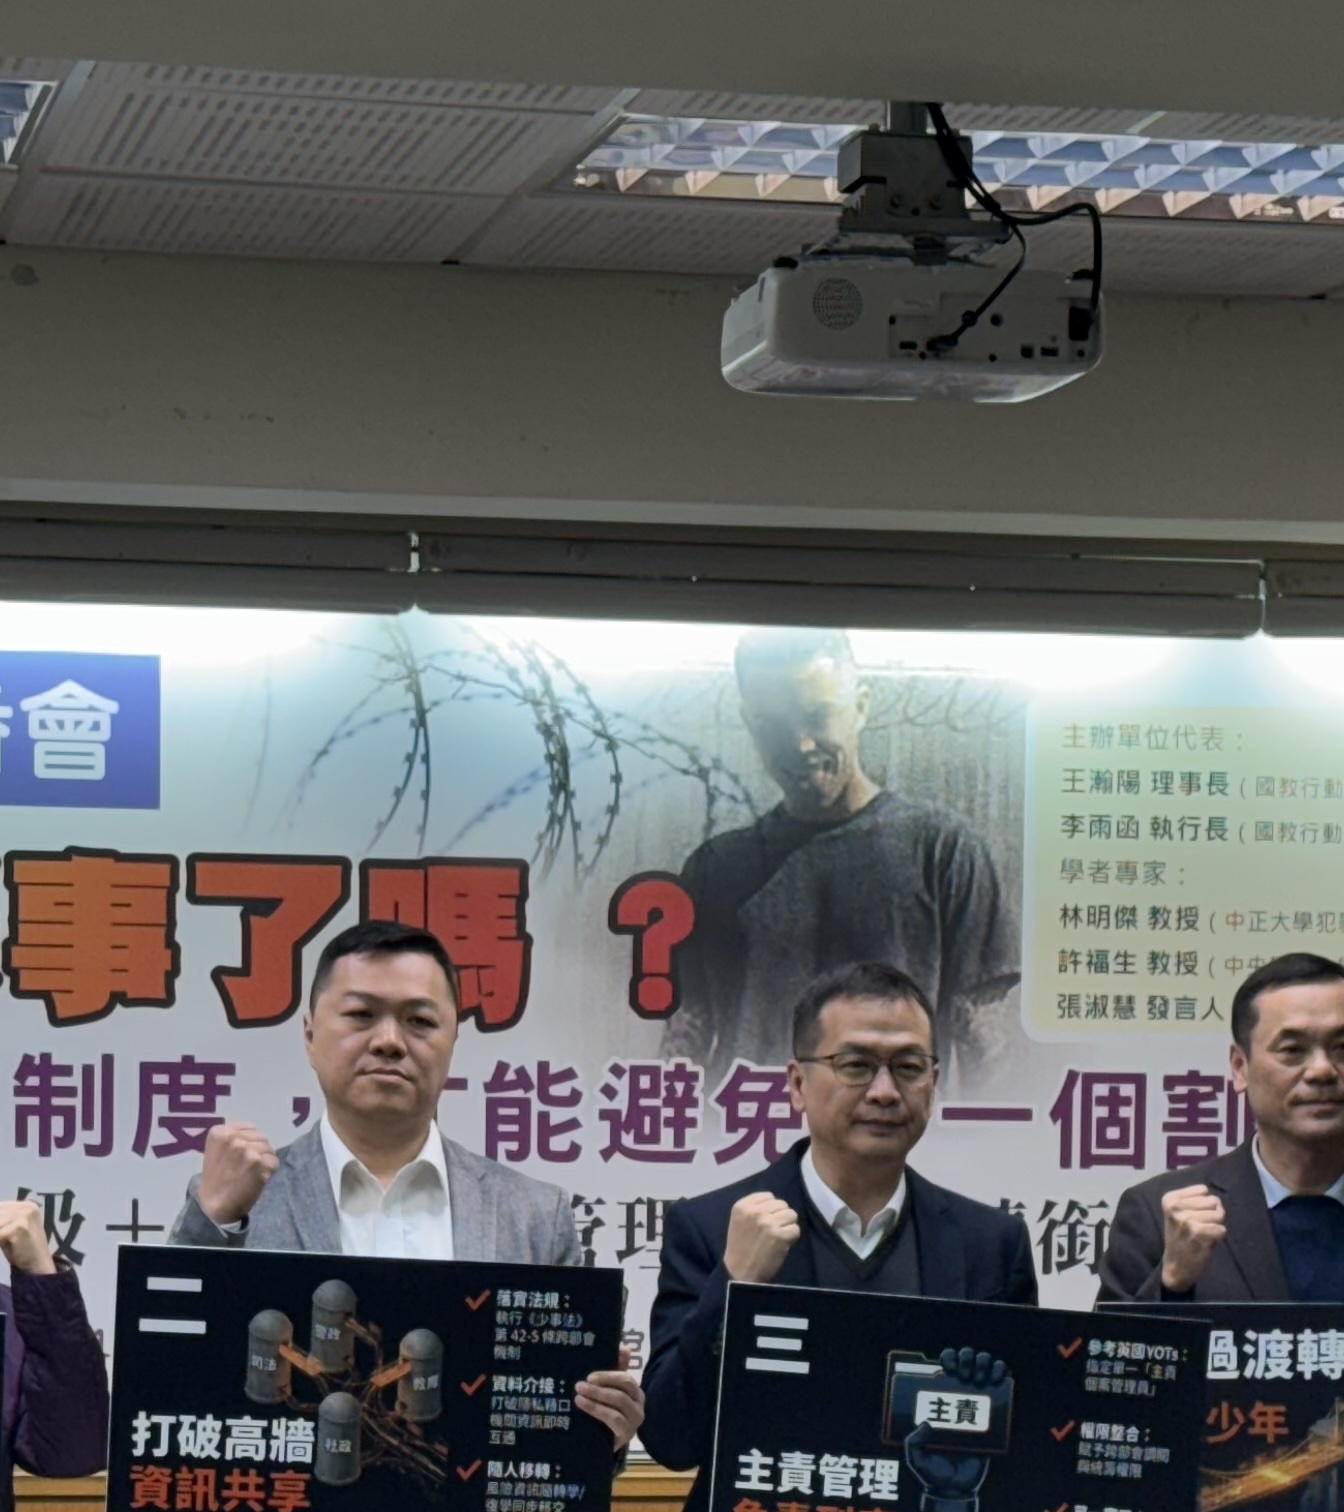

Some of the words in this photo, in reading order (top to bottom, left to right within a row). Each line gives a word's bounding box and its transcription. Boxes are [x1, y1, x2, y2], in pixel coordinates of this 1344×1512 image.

[1061, 723, 1243, 752] 主辦單位代表：
[1061, 769, 1141, 796] 王瀚陽
[1060, 814, 1140, 841] 李雨函
[1059, 857, 1186, 887] 學者專家：
[1059, 904, 1138, 930] 林明傑
[1059, 949, 1137, 975] 許福生
[1058, 994, 1137, 1020] 張淑慧
[1146, 995, 1225, 1022] 發言人
[138, 1276, 207, 1335] 二
[745, 1314, 810, 1374] 三
[928, 1398, 980, 1426] 主責
[1206, 1401, 1289, 1444] 少年
[131, 1412, 315, 1464] 打破高牆
[735, 1449, 899, 1501] 主責管理
